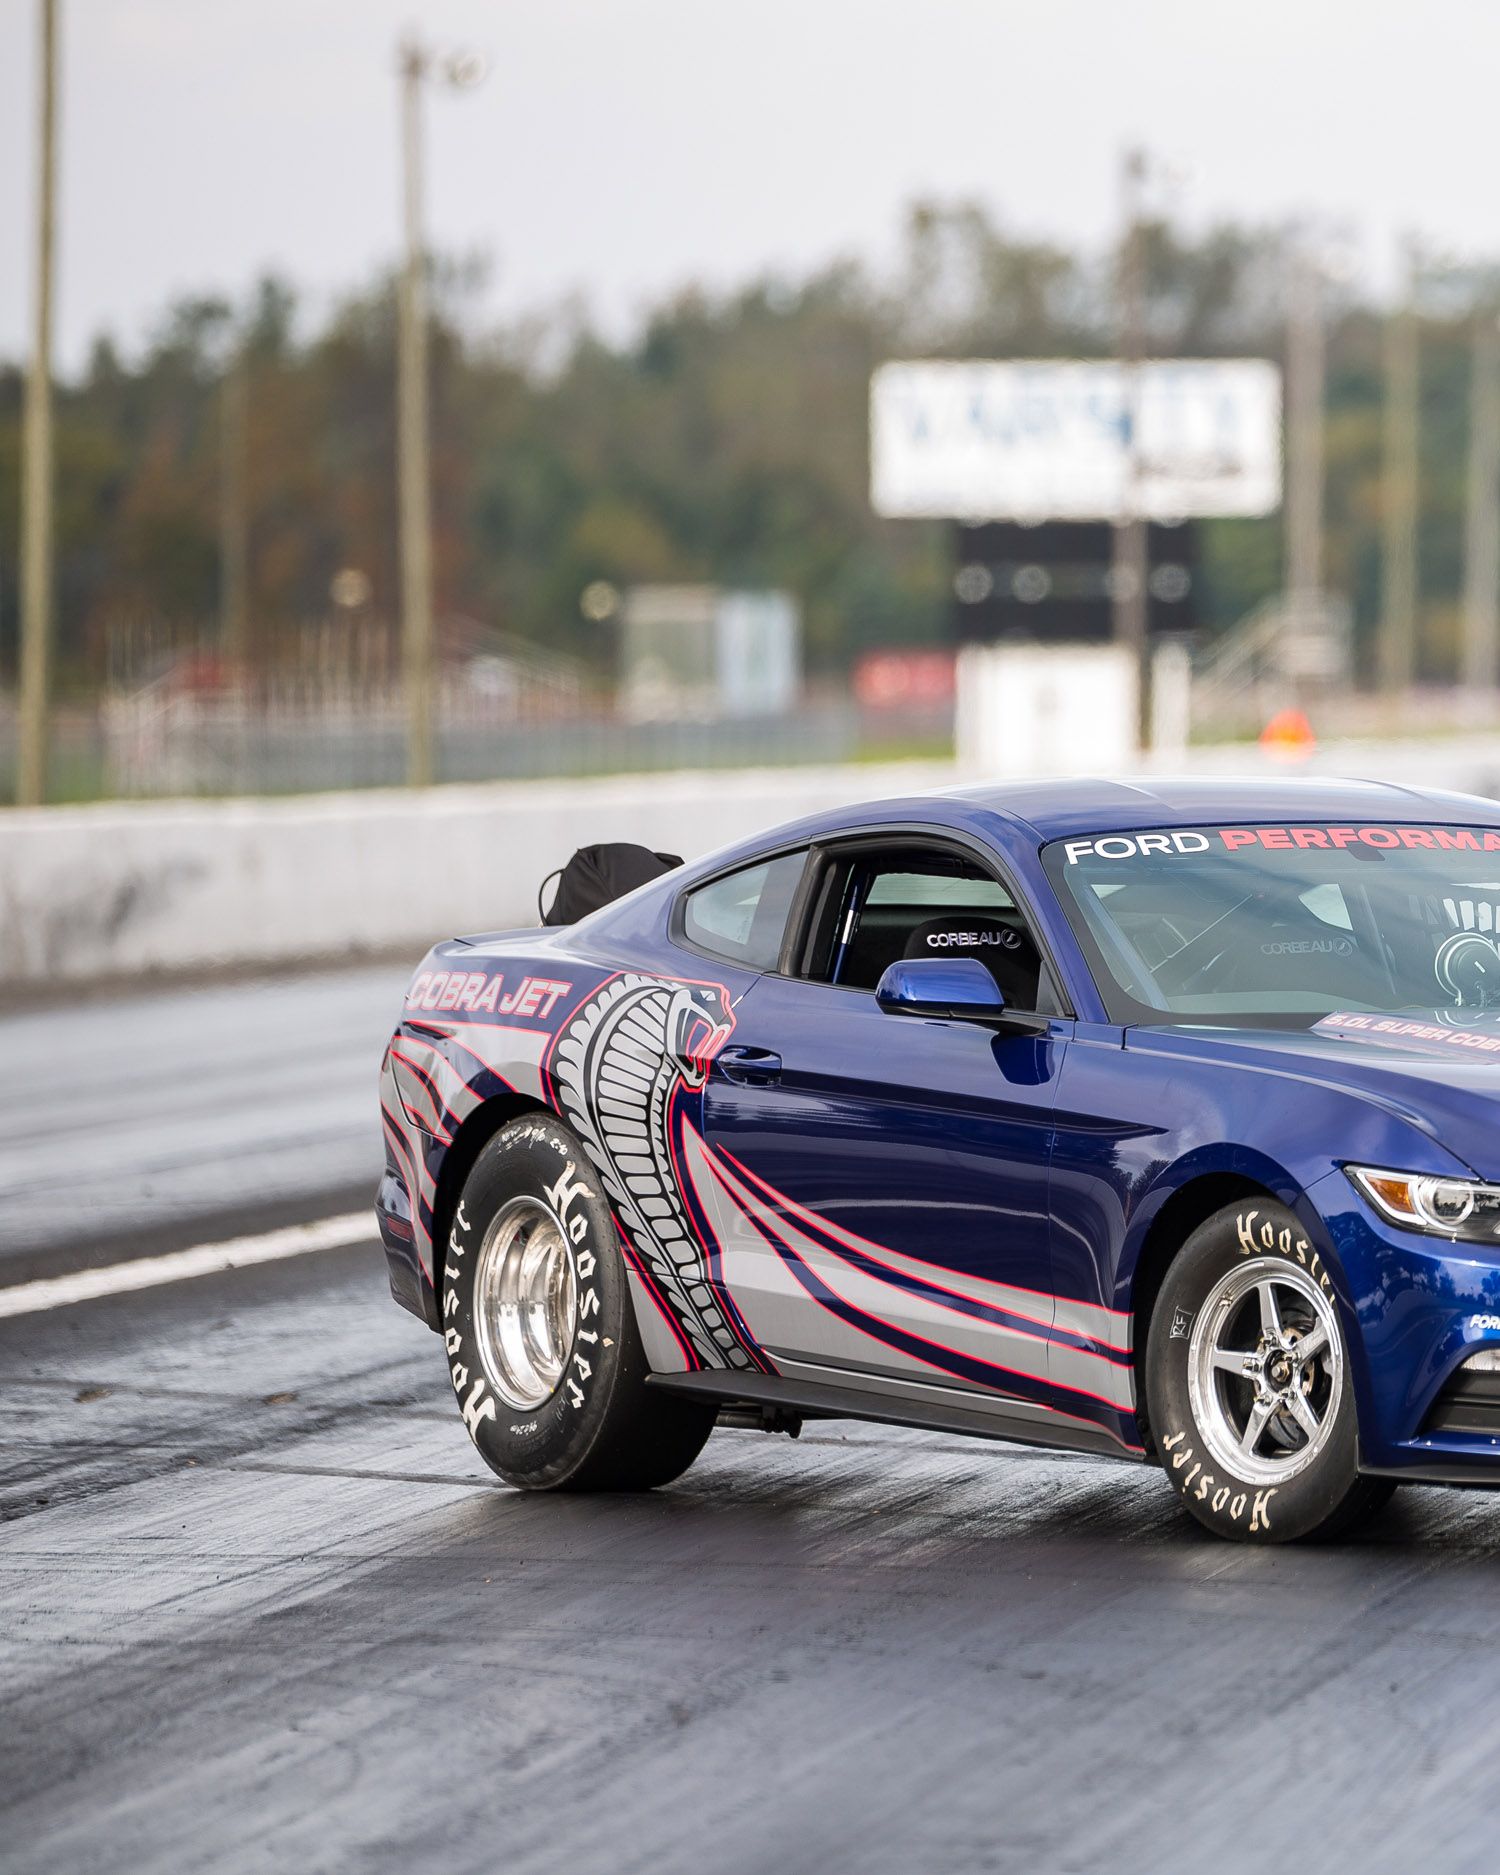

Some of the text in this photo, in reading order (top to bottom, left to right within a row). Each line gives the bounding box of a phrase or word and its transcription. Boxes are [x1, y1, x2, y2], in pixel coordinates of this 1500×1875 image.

[1064, 832, 1210, 865] FORD
[926, 932, 1000, 947] CORBEAU
[1261, 940, 1333, 955] CORBEAU
[405, 971, 573, 1019] COBRA JET
[1322, 1014, 1375, 1029] 5.0L
[1370, 1020, 1454, 1041] SUPER
[1172, 1314, 1187, 1336] RF
